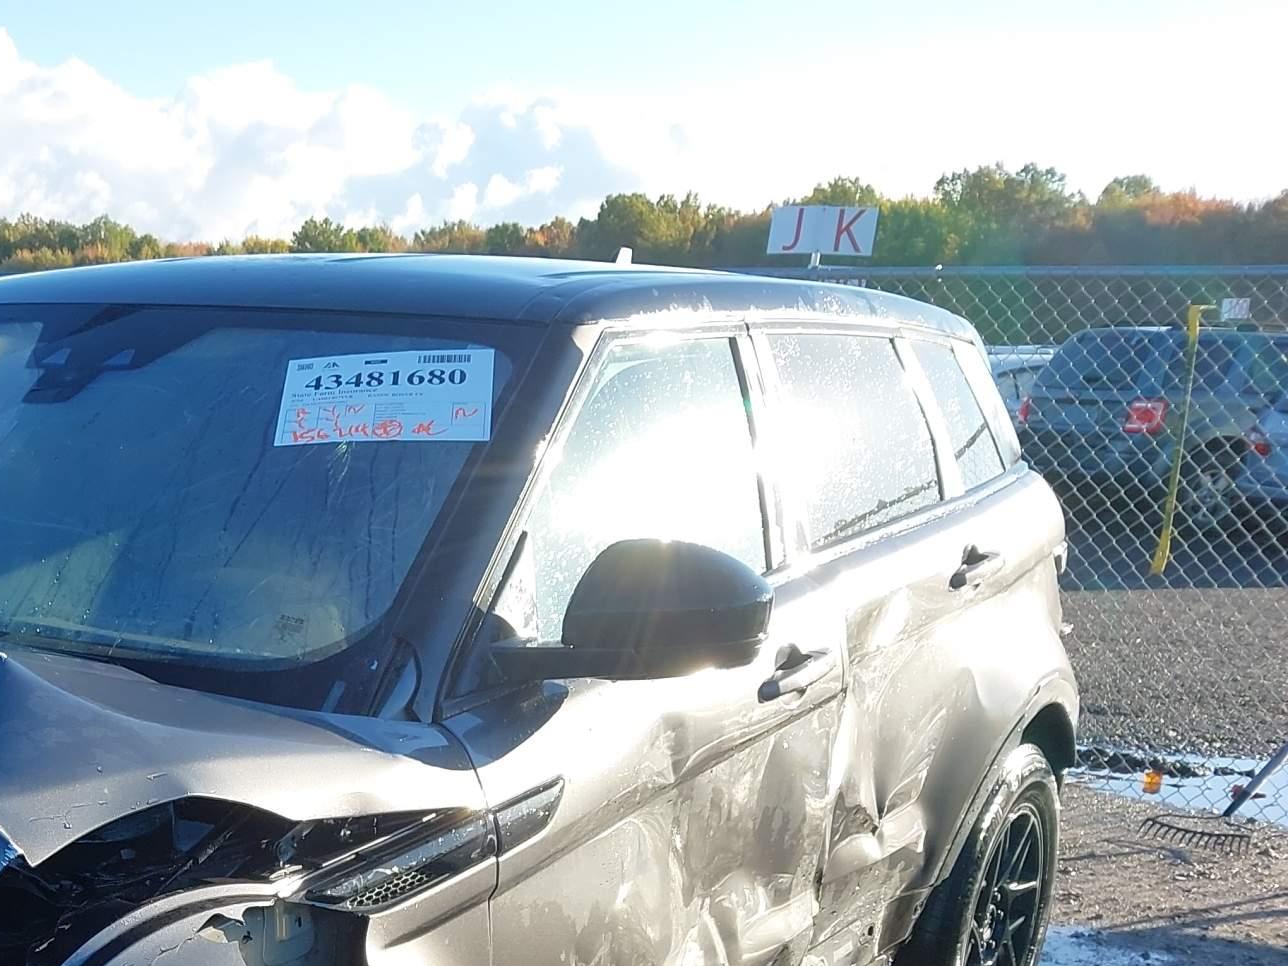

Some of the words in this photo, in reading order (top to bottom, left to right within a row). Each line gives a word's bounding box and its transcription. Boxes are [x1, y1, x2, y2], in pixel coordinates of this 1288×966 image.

[782, 207, 805, 251] J
[833, 208, 868, 253] K
[305, 368, 467, 391] 43481680
